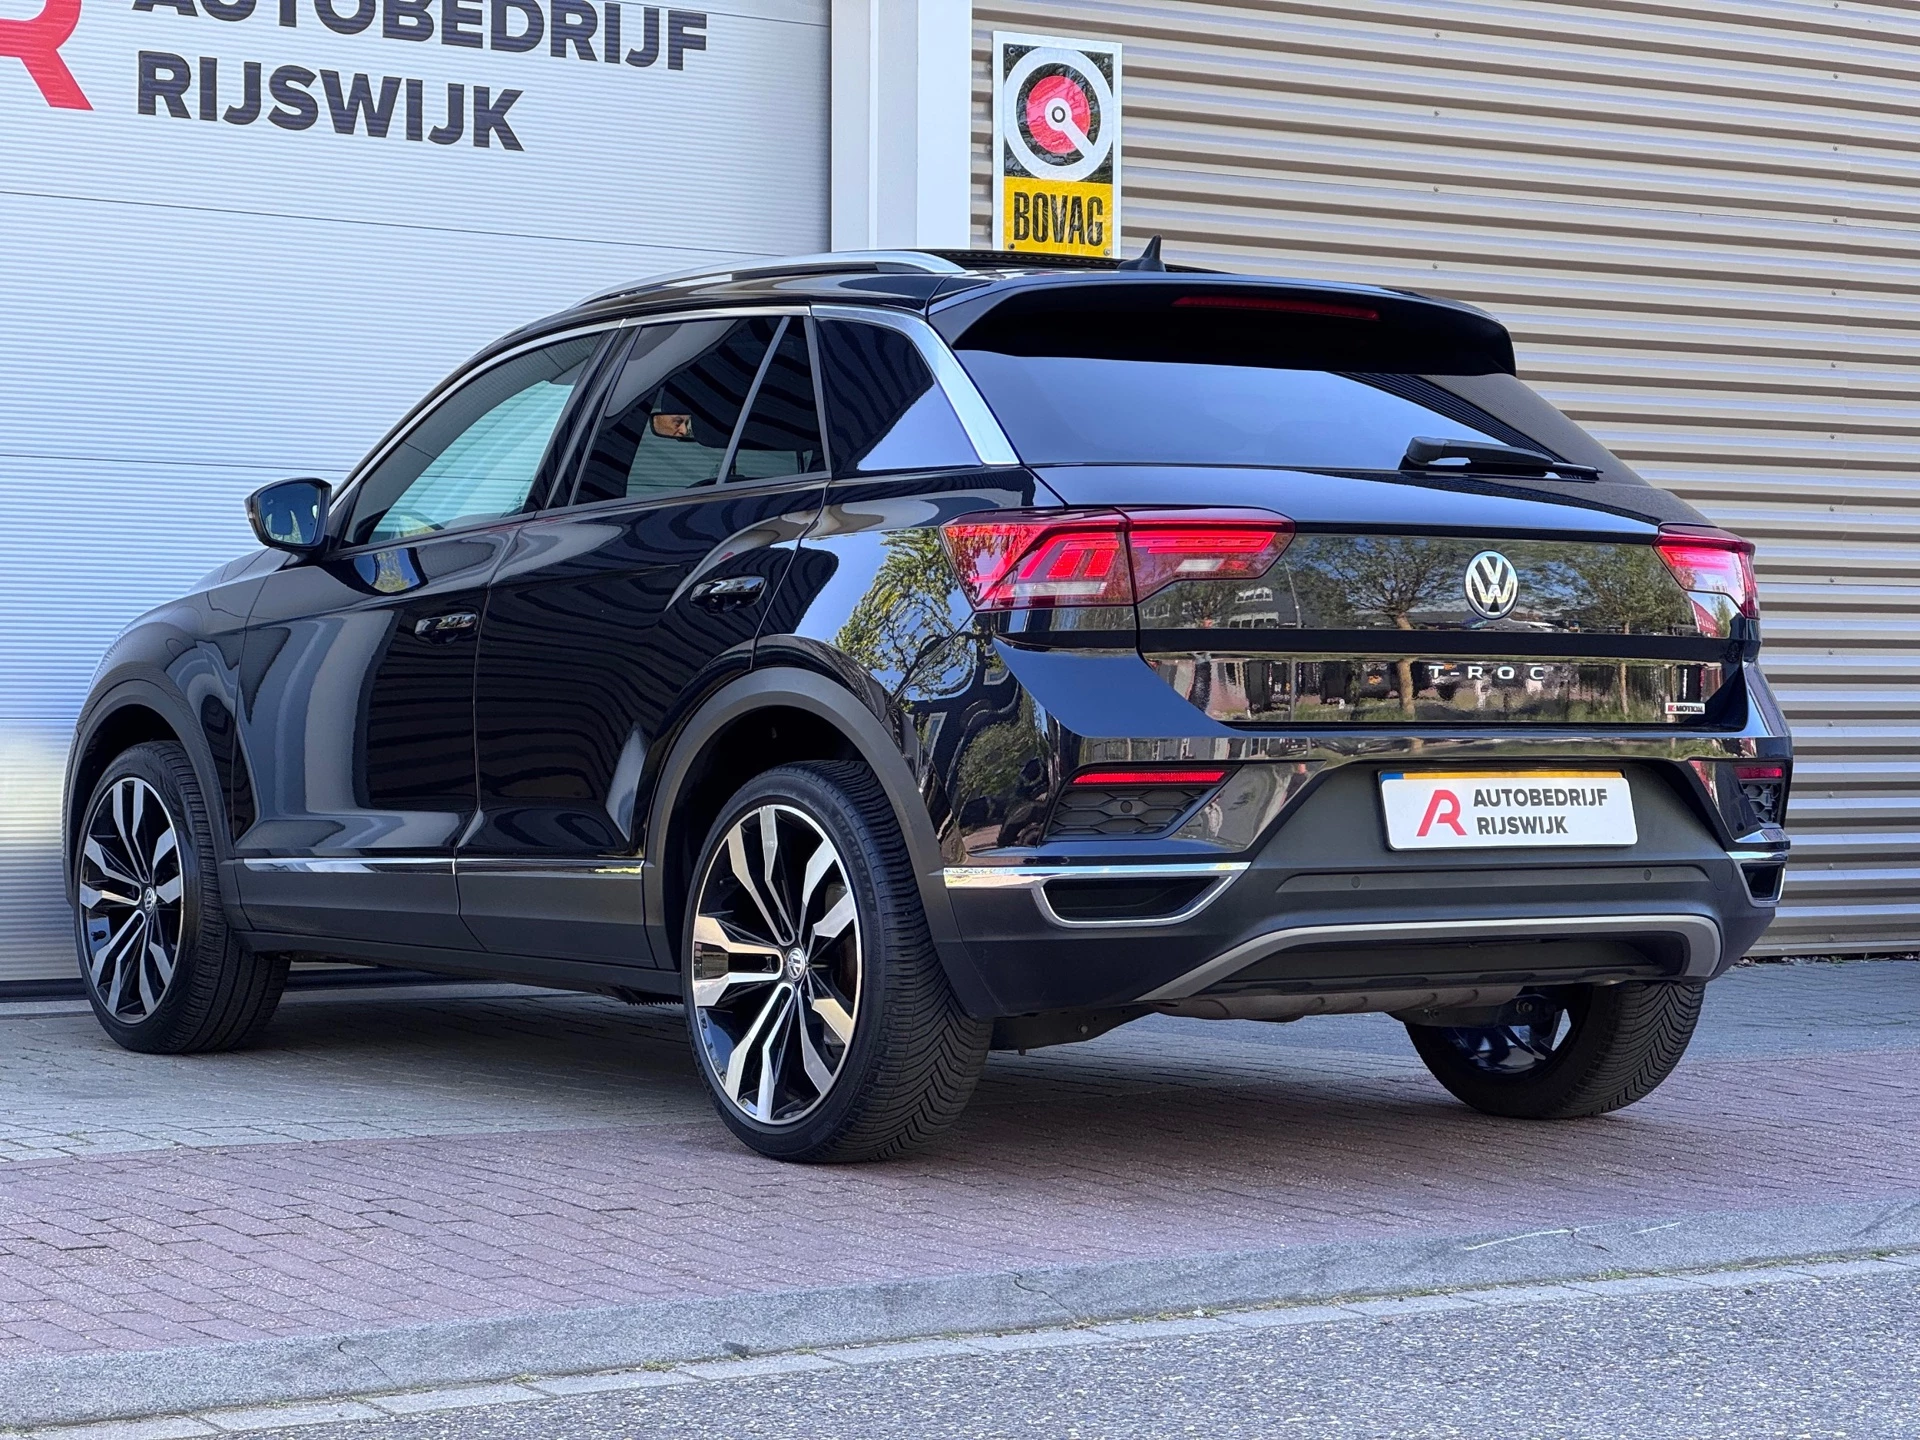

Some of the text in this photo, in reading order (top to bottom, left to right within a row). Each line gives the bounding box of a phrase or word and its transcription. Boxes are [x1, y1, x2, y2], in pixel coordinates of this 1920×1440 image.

[132, 0, 707, 71] OBEDRIJF
[137, 50, 524, 151] RIJSWIJK
[1013, 191, 1104, 247] BOVAG
[1428, 665, 1545, 680] T-ROC
[1473, 788, 1608, 808] AUTOBEDRIJF
[1476, 816, 1569, 836] RIJSWIJK
